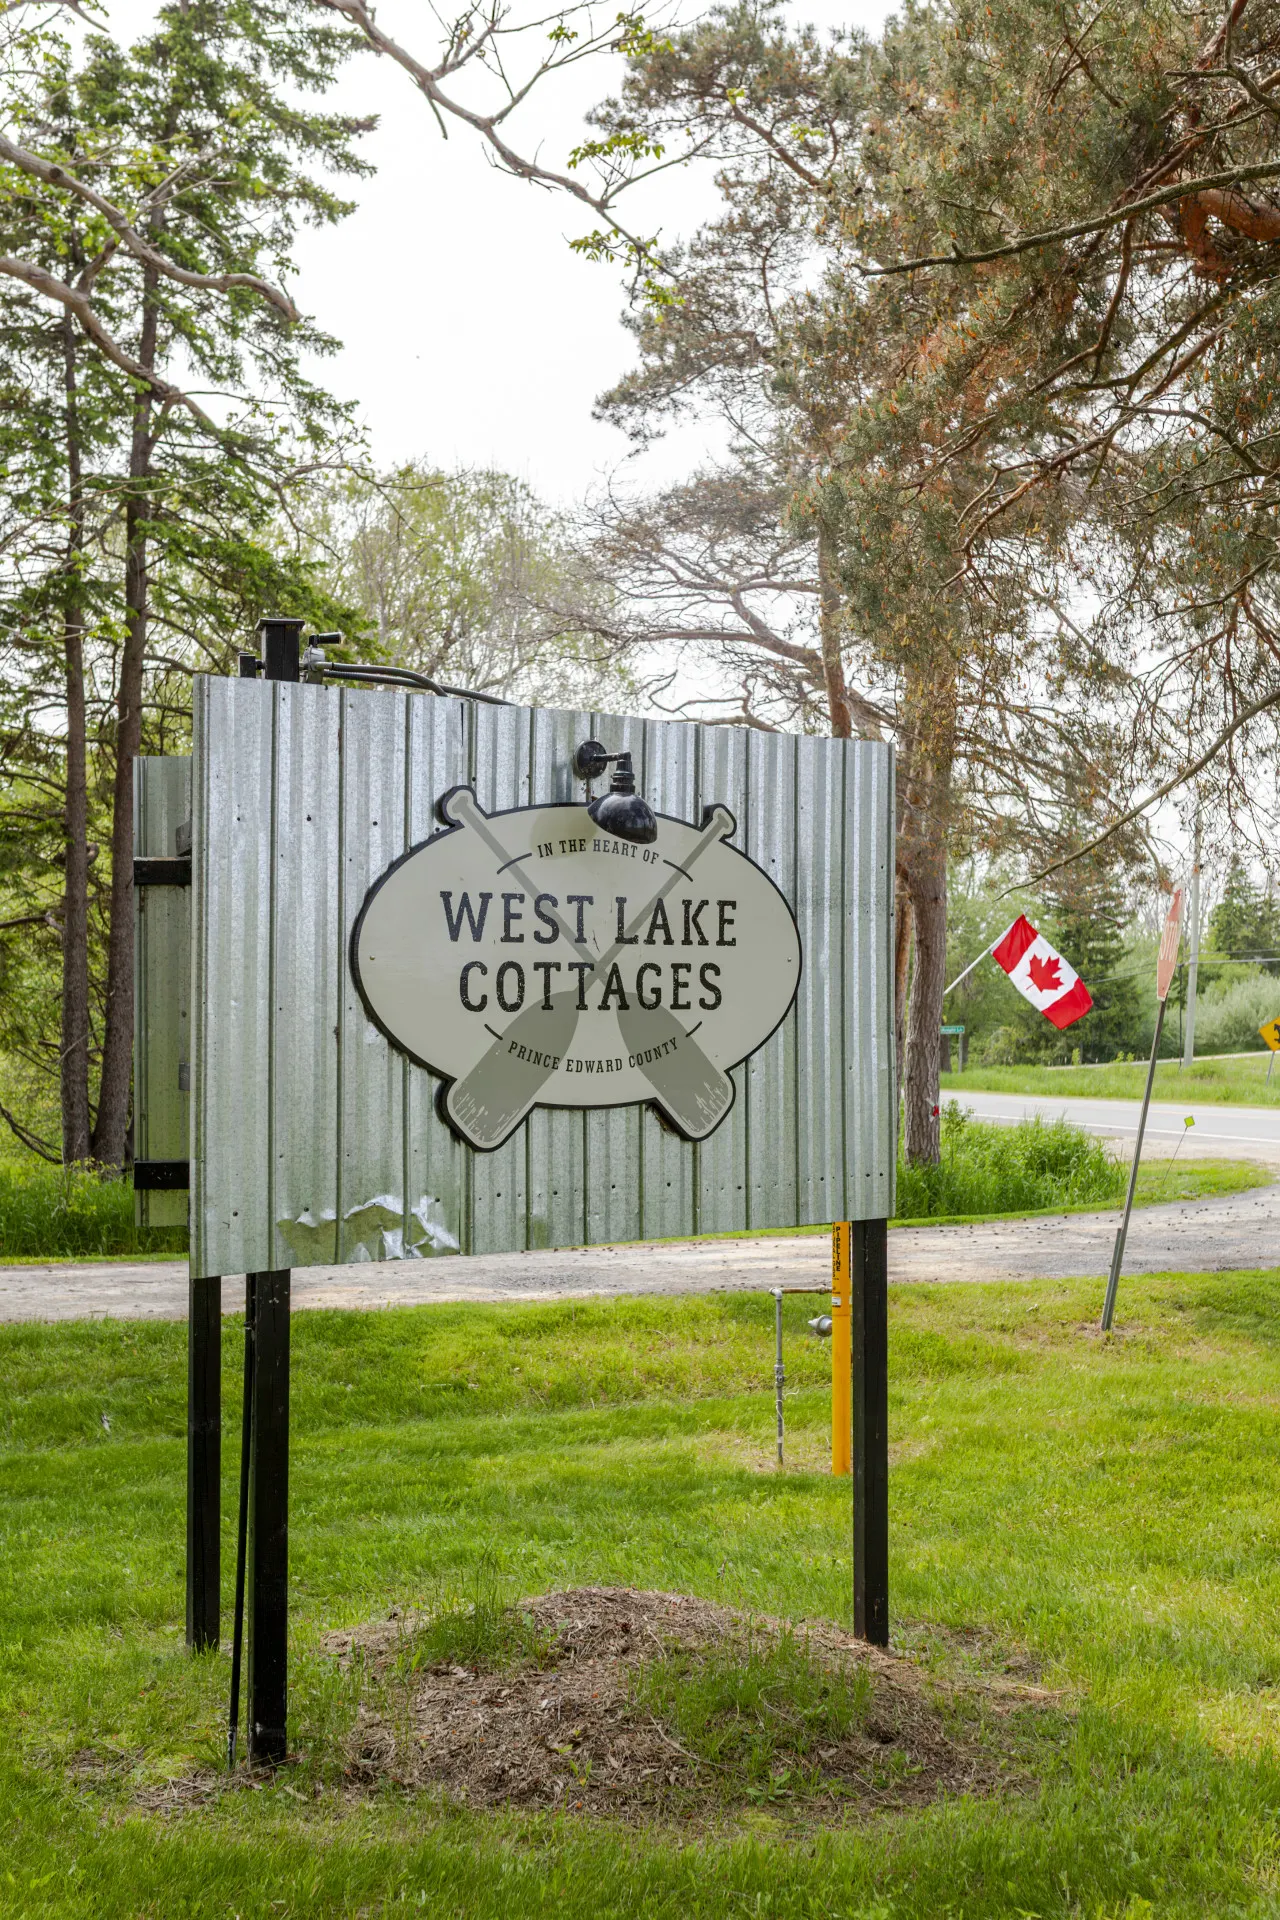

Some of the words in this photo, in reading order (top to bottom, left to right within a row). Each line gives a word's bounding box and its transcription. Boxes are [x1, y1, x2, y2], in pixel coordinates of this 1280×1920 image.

[537, 842, 553, 858] IN
[559, 839, 586, 853] THE
[593, 839, 638, 858] HEART
[643, 849, 659, 864] OF
[440, 891, 594, 944] WEST
[615, 897, 737, 946] LAKE
[459, 961, 722, 1012] COTTAGES
[508, 1040, 560, 1070] PRINCE
[566, 1058, 623, 1073] EDWARD
[628, 1037, 678, 1068] COUNTY
